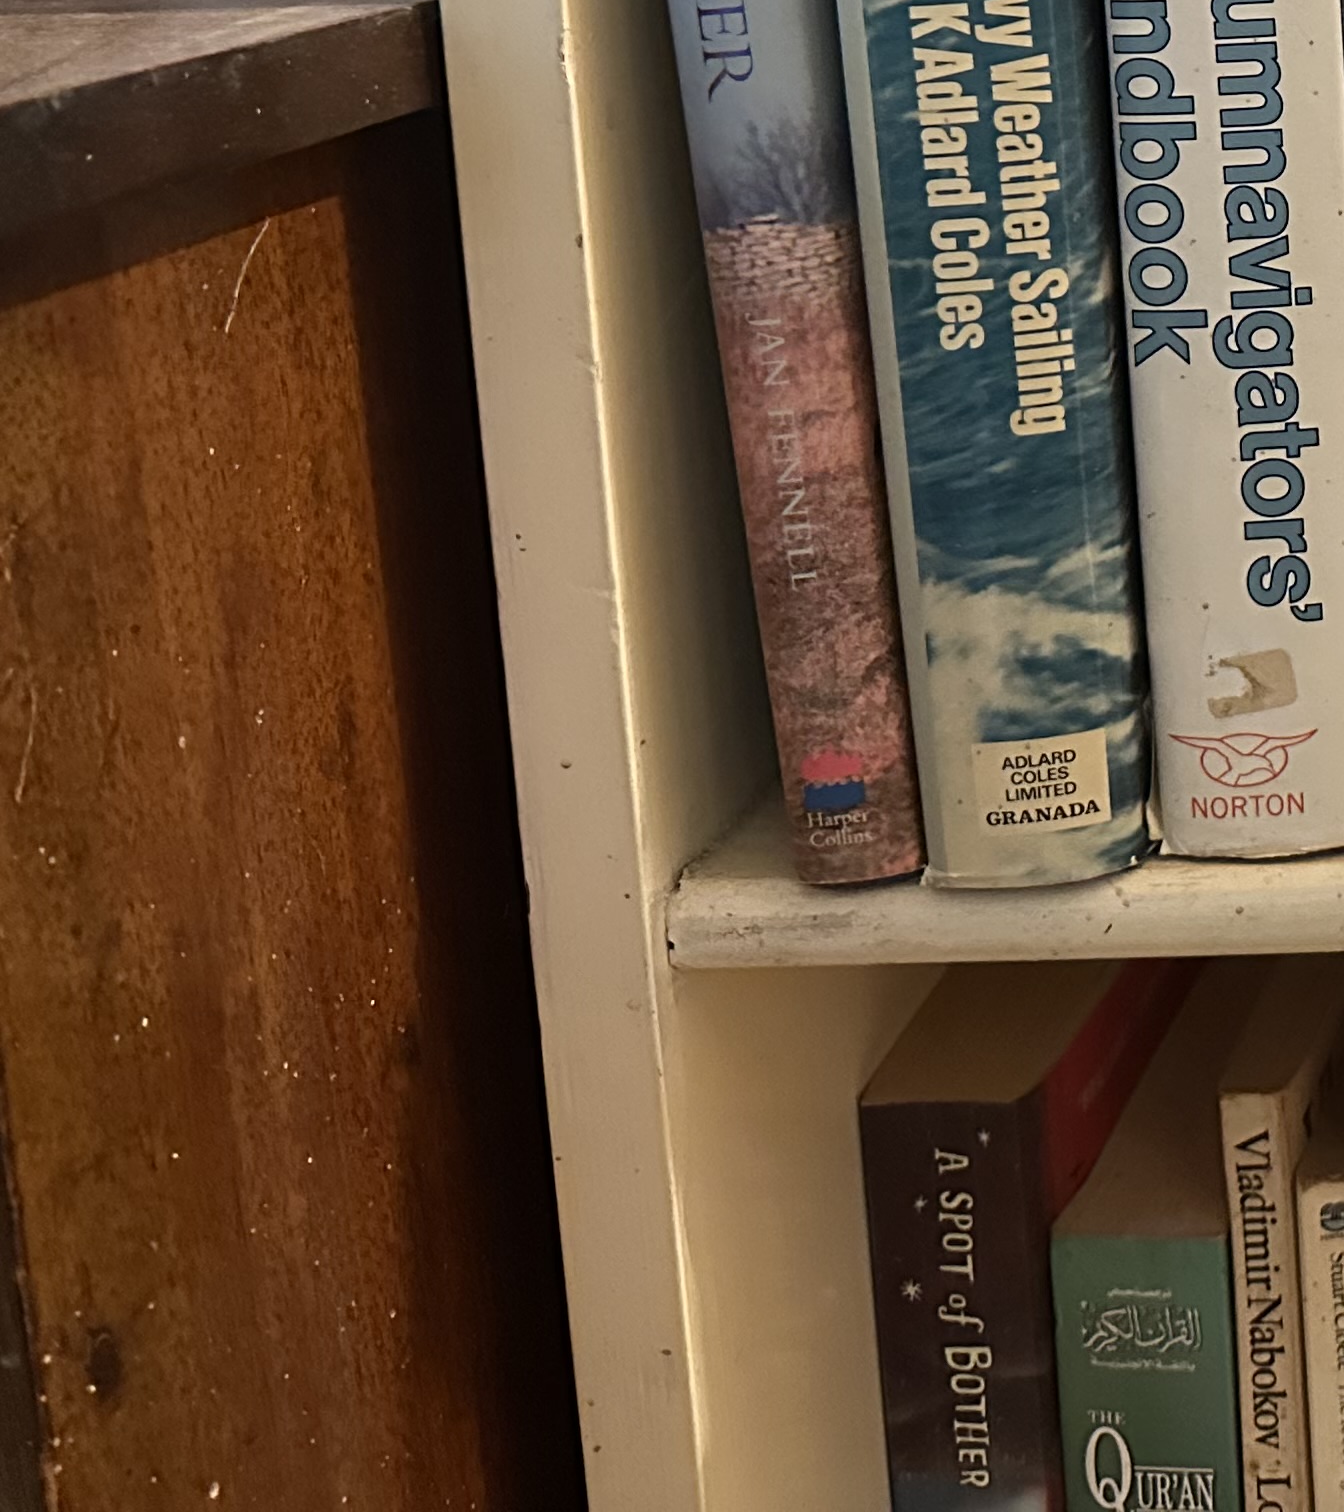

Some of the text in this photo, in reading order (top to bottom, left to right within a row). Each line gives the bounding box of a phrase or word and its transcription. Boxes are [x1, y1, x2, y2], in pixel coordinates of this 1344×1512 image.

[907, 1, 995, 352] K Adlard Coles
[988, 53, 1061, 262] Weather
[1007, 266, 1076, 438] Sailing
[1000, 747, 1078, 773] ADLARD
[1008, 765, 1070, 786] COLES
[984, 798, 1102, 829] GRANADA
[1004, 780, 1078, 803] LIMITED
[1190, 790, 1306, 821] NORTON
[933, 1146, 994, 1490] A SPOT of BOTHER
[1232, 1127, 1287, 1452] Vladimir Nabokov
[1086, 1408, 1127, 1426] THE
[1084, 1425, 1215, 1512] QUR'AN
